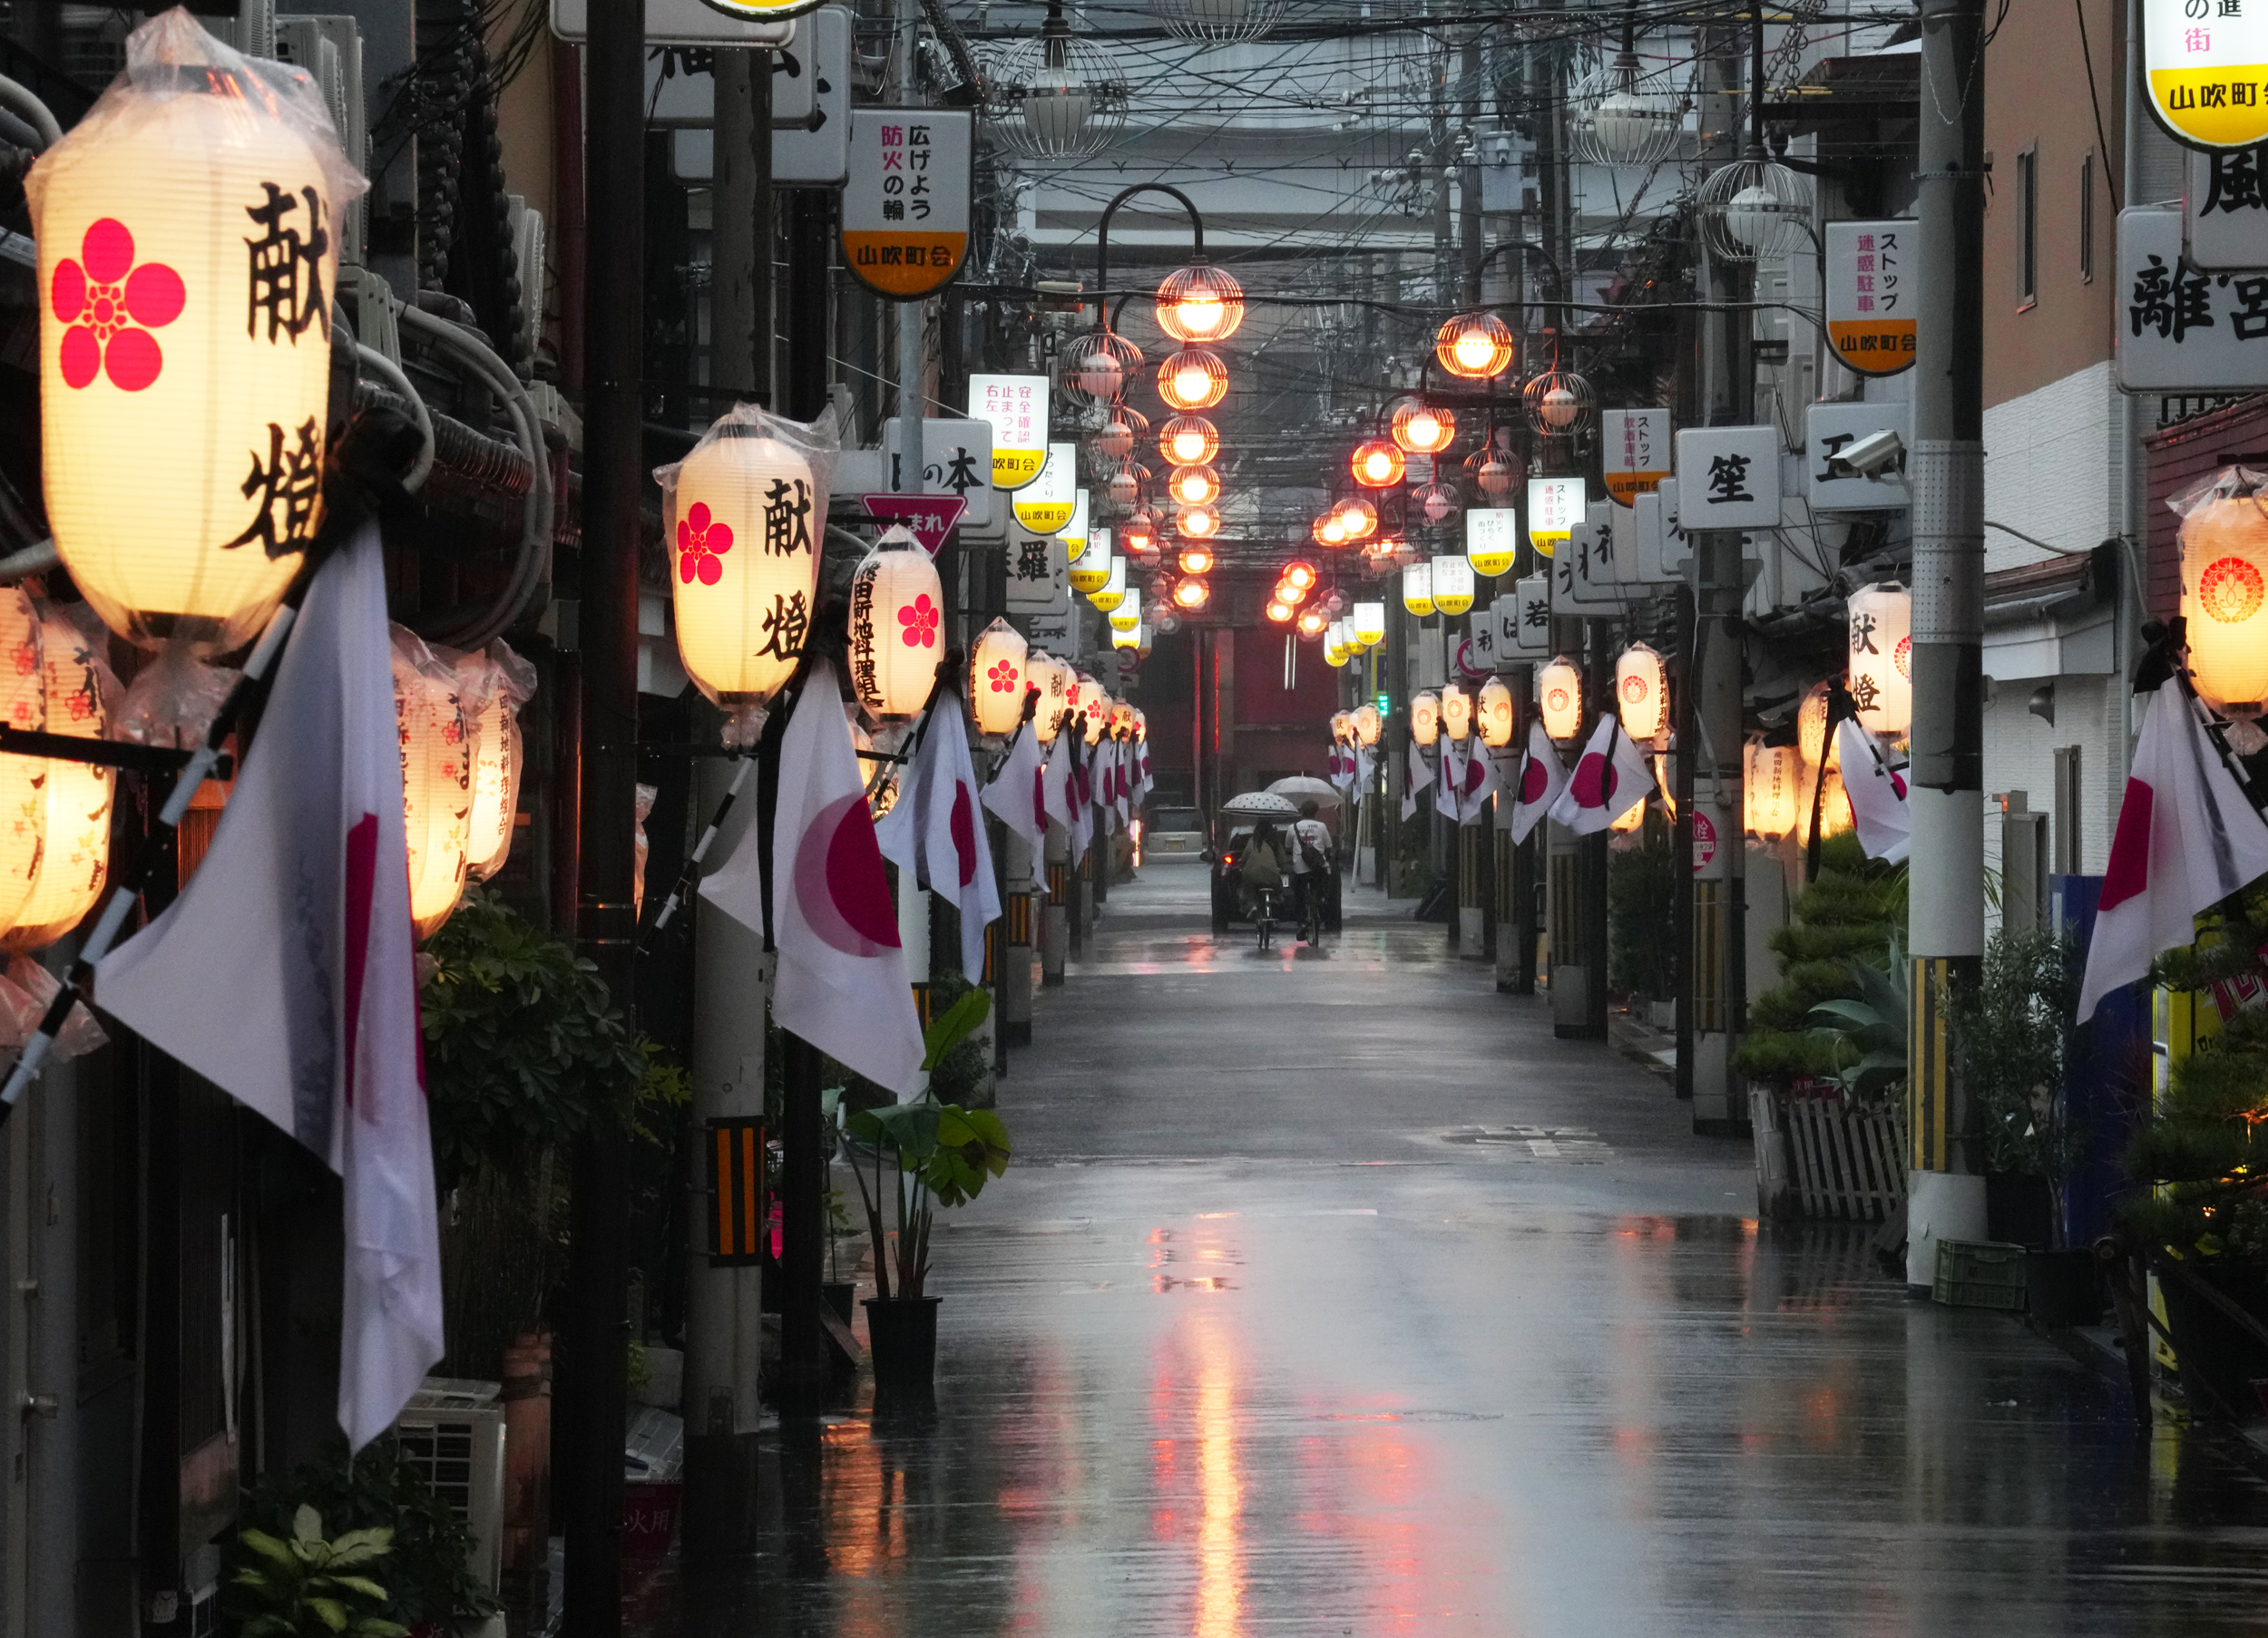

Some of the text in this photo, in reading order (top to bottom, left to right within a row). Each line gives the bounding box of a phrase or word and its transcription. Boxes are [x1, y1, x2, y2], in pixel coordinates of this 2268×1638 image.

[2169, 82, 2268, 110] 山吹町
[882, 125, 904, 220] 防火の輪
[908, 125, 932, 220] 広げよう
[857, 246, 953, 267] 山吹町会
[1857, 234, 1874, 312] 迷惑駐車
[1881, 233, 1898, 311] ストップ
[1841, 334, 1916, 352] 山吹町会
[986, 385, 999, 412] 右左
[1001, 385, 1013, 442] 止まって
[1018, 385, 1031, 443] 安全確認
[1638, 417, 1650, 466] ストップ
[892, 446, 984, 496] の本
[1706, 453, 1754, 504] 笙
[885, 512, 945, 533] まれ
[1021, 511, 1066, 521] 山吹町会
[1006, 540, 1050, 582] 羅
[1474, 559, 1510, 568] 山吹町会
